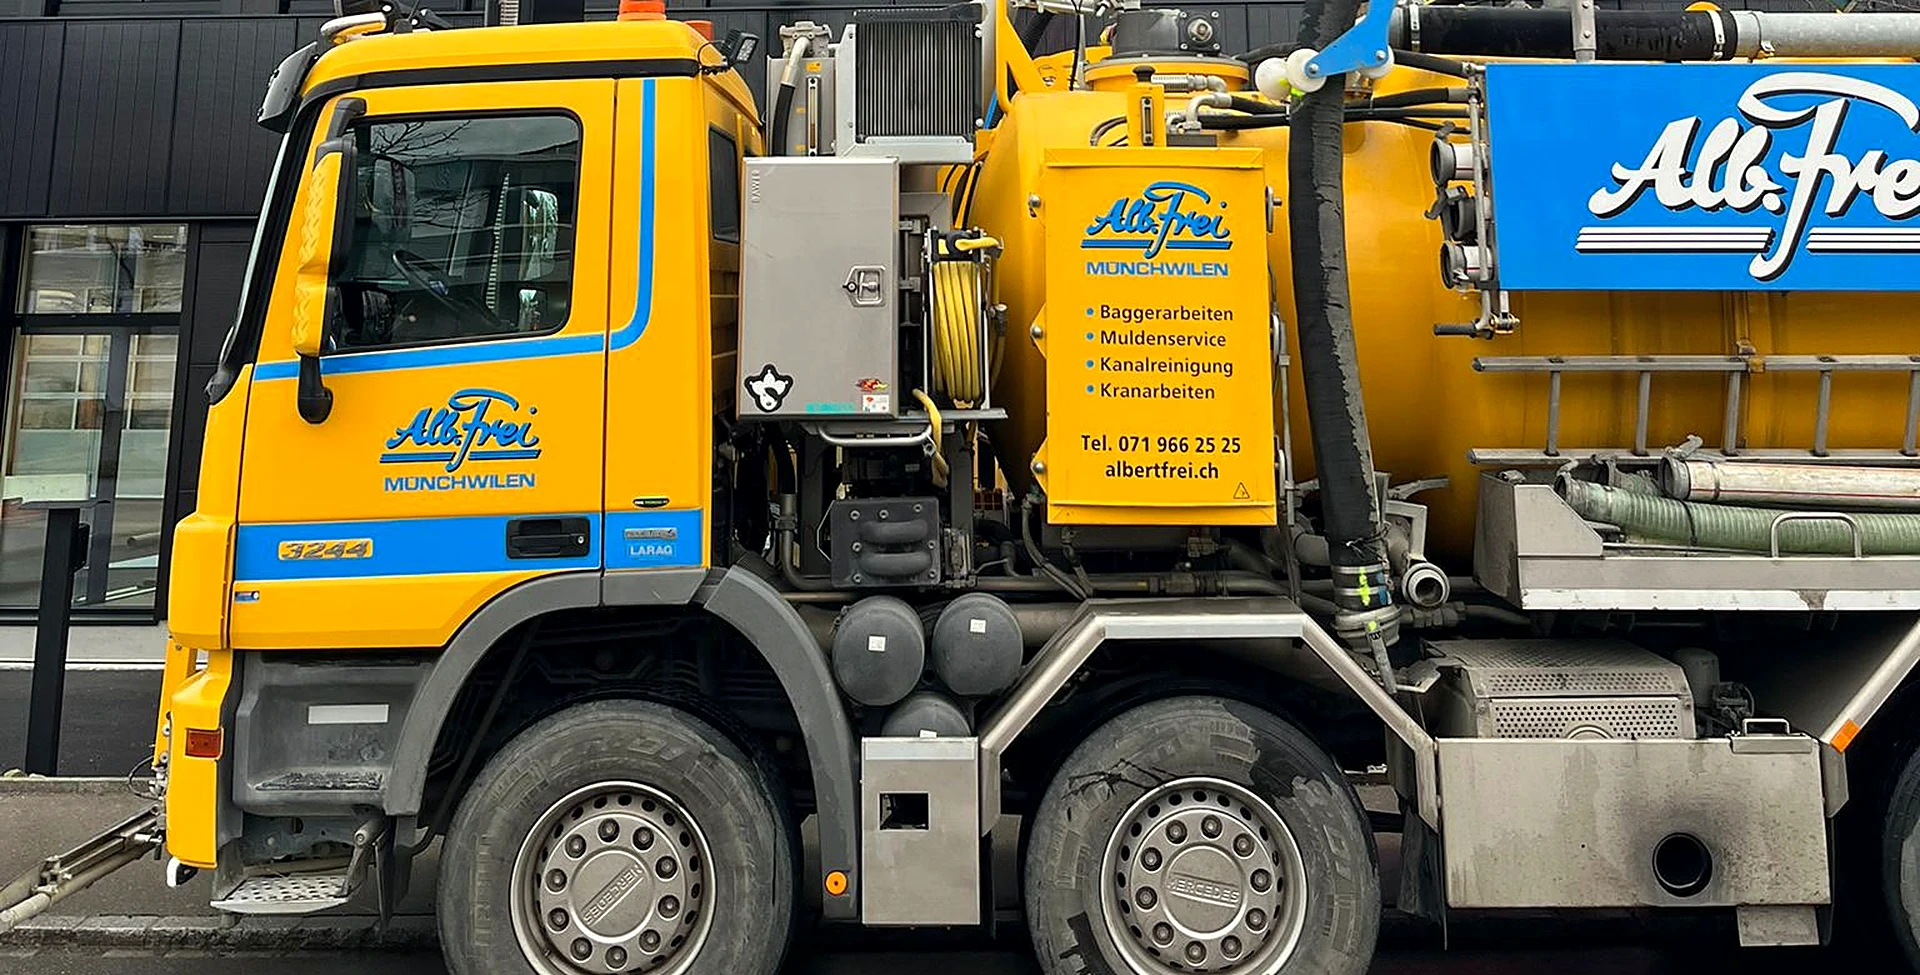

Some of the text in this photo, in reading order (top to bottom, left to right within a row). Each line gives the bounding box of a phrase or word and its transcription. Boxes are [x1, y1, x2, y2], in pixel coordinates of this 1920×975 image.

[1085, 261, 1229, 277] MÜNCHWILEN
[1099, 304, 1234, 324] Baggerarbeiten
[1099, 330, 1227, 347] Muldenservice
[1099, 356, 1234, 378] Kanalreinigung
[1099, 382, 1215, 399] Kranarbeiten
[1081, 434, 1241, 454] Tel. 071 966 25 25
[1105, 460, 1219, 479] albertfrei.ch
[384, 473, 536, 492] MÜNCHWILEN
[281, 541, 369, 560] 3244
[629, 544, 674, 556] LARAG
[582, 862, 643, 926] MERCEDES
[1166, 878, 1241, 904] MERCEDES
